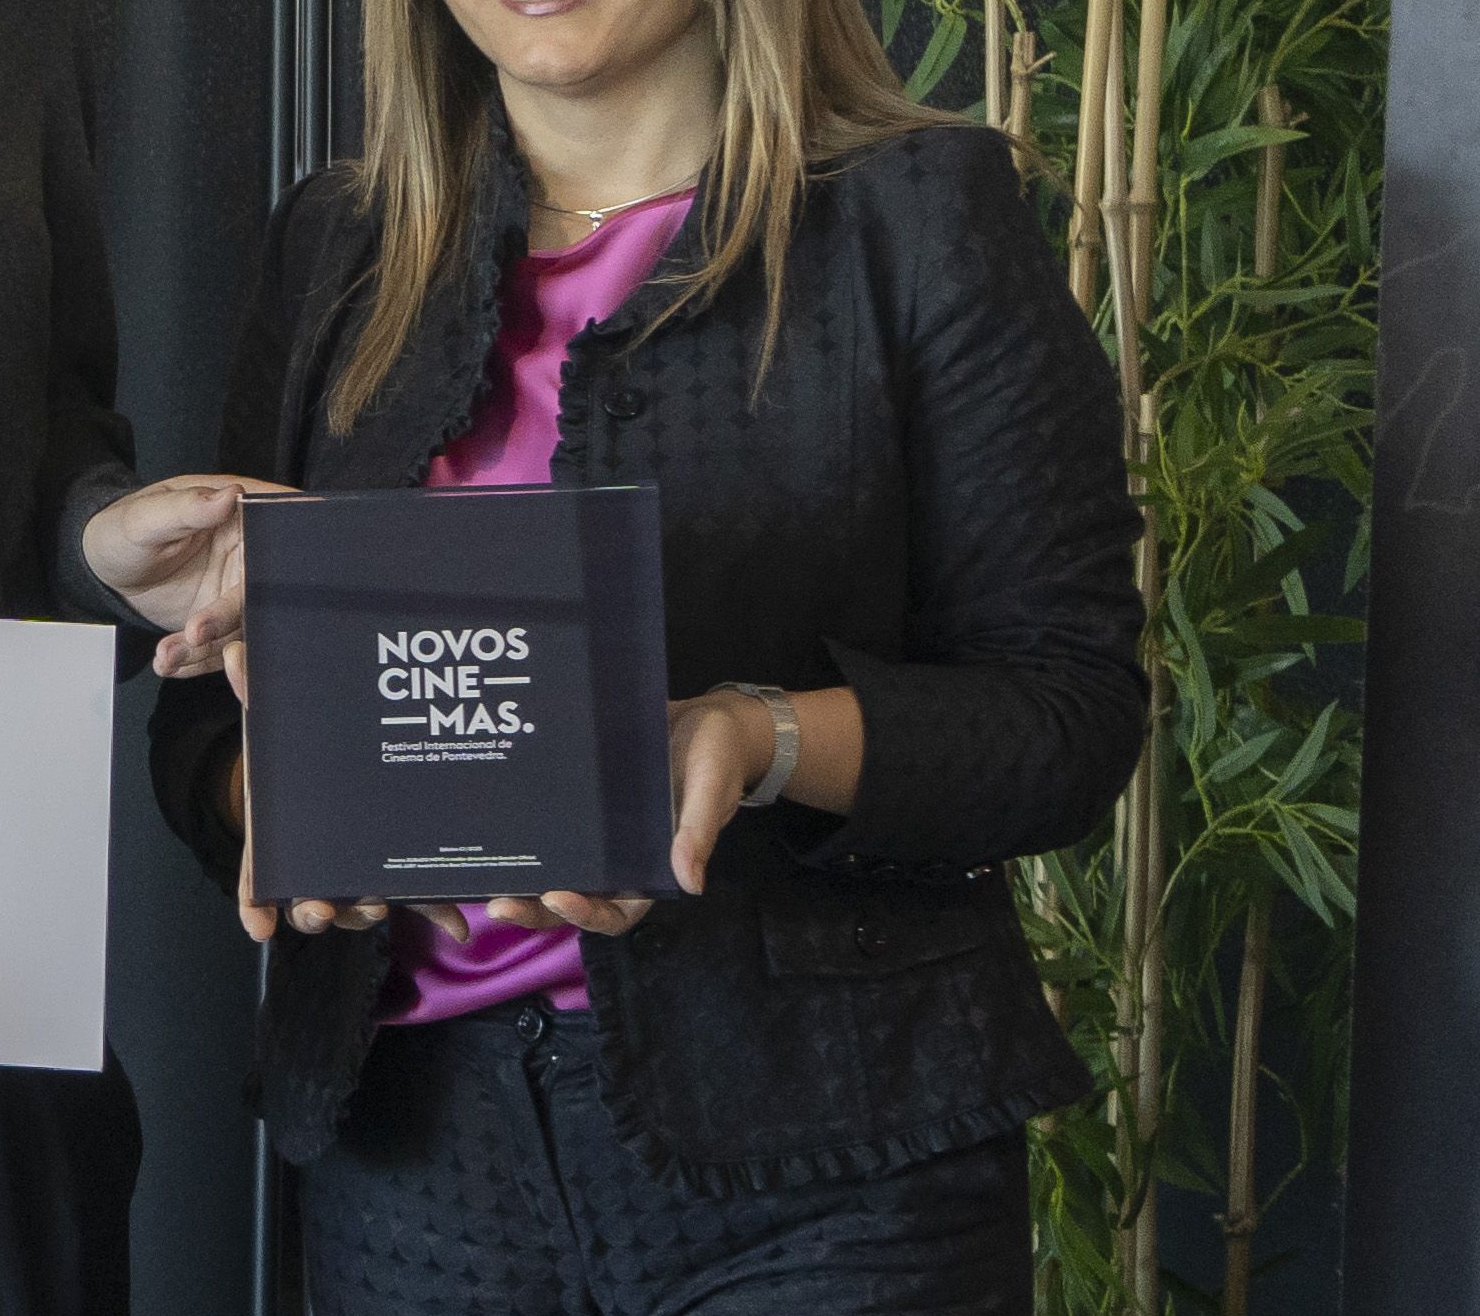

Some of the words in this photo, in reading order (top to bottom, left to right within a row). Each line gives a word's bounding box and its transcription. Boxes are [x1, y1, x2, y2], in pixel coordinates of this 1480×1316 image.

[377, 627, 530, 664] NOVOS
[381, 741, 423, 752] Festival
[424, 739, 497, 751] Internacional
[497, 739, 513, 749] de
[381, 753, 424, 763] Cinema
[424, 752, 440, 762] de
[441, 751, 508, 762] Pontevedra.
